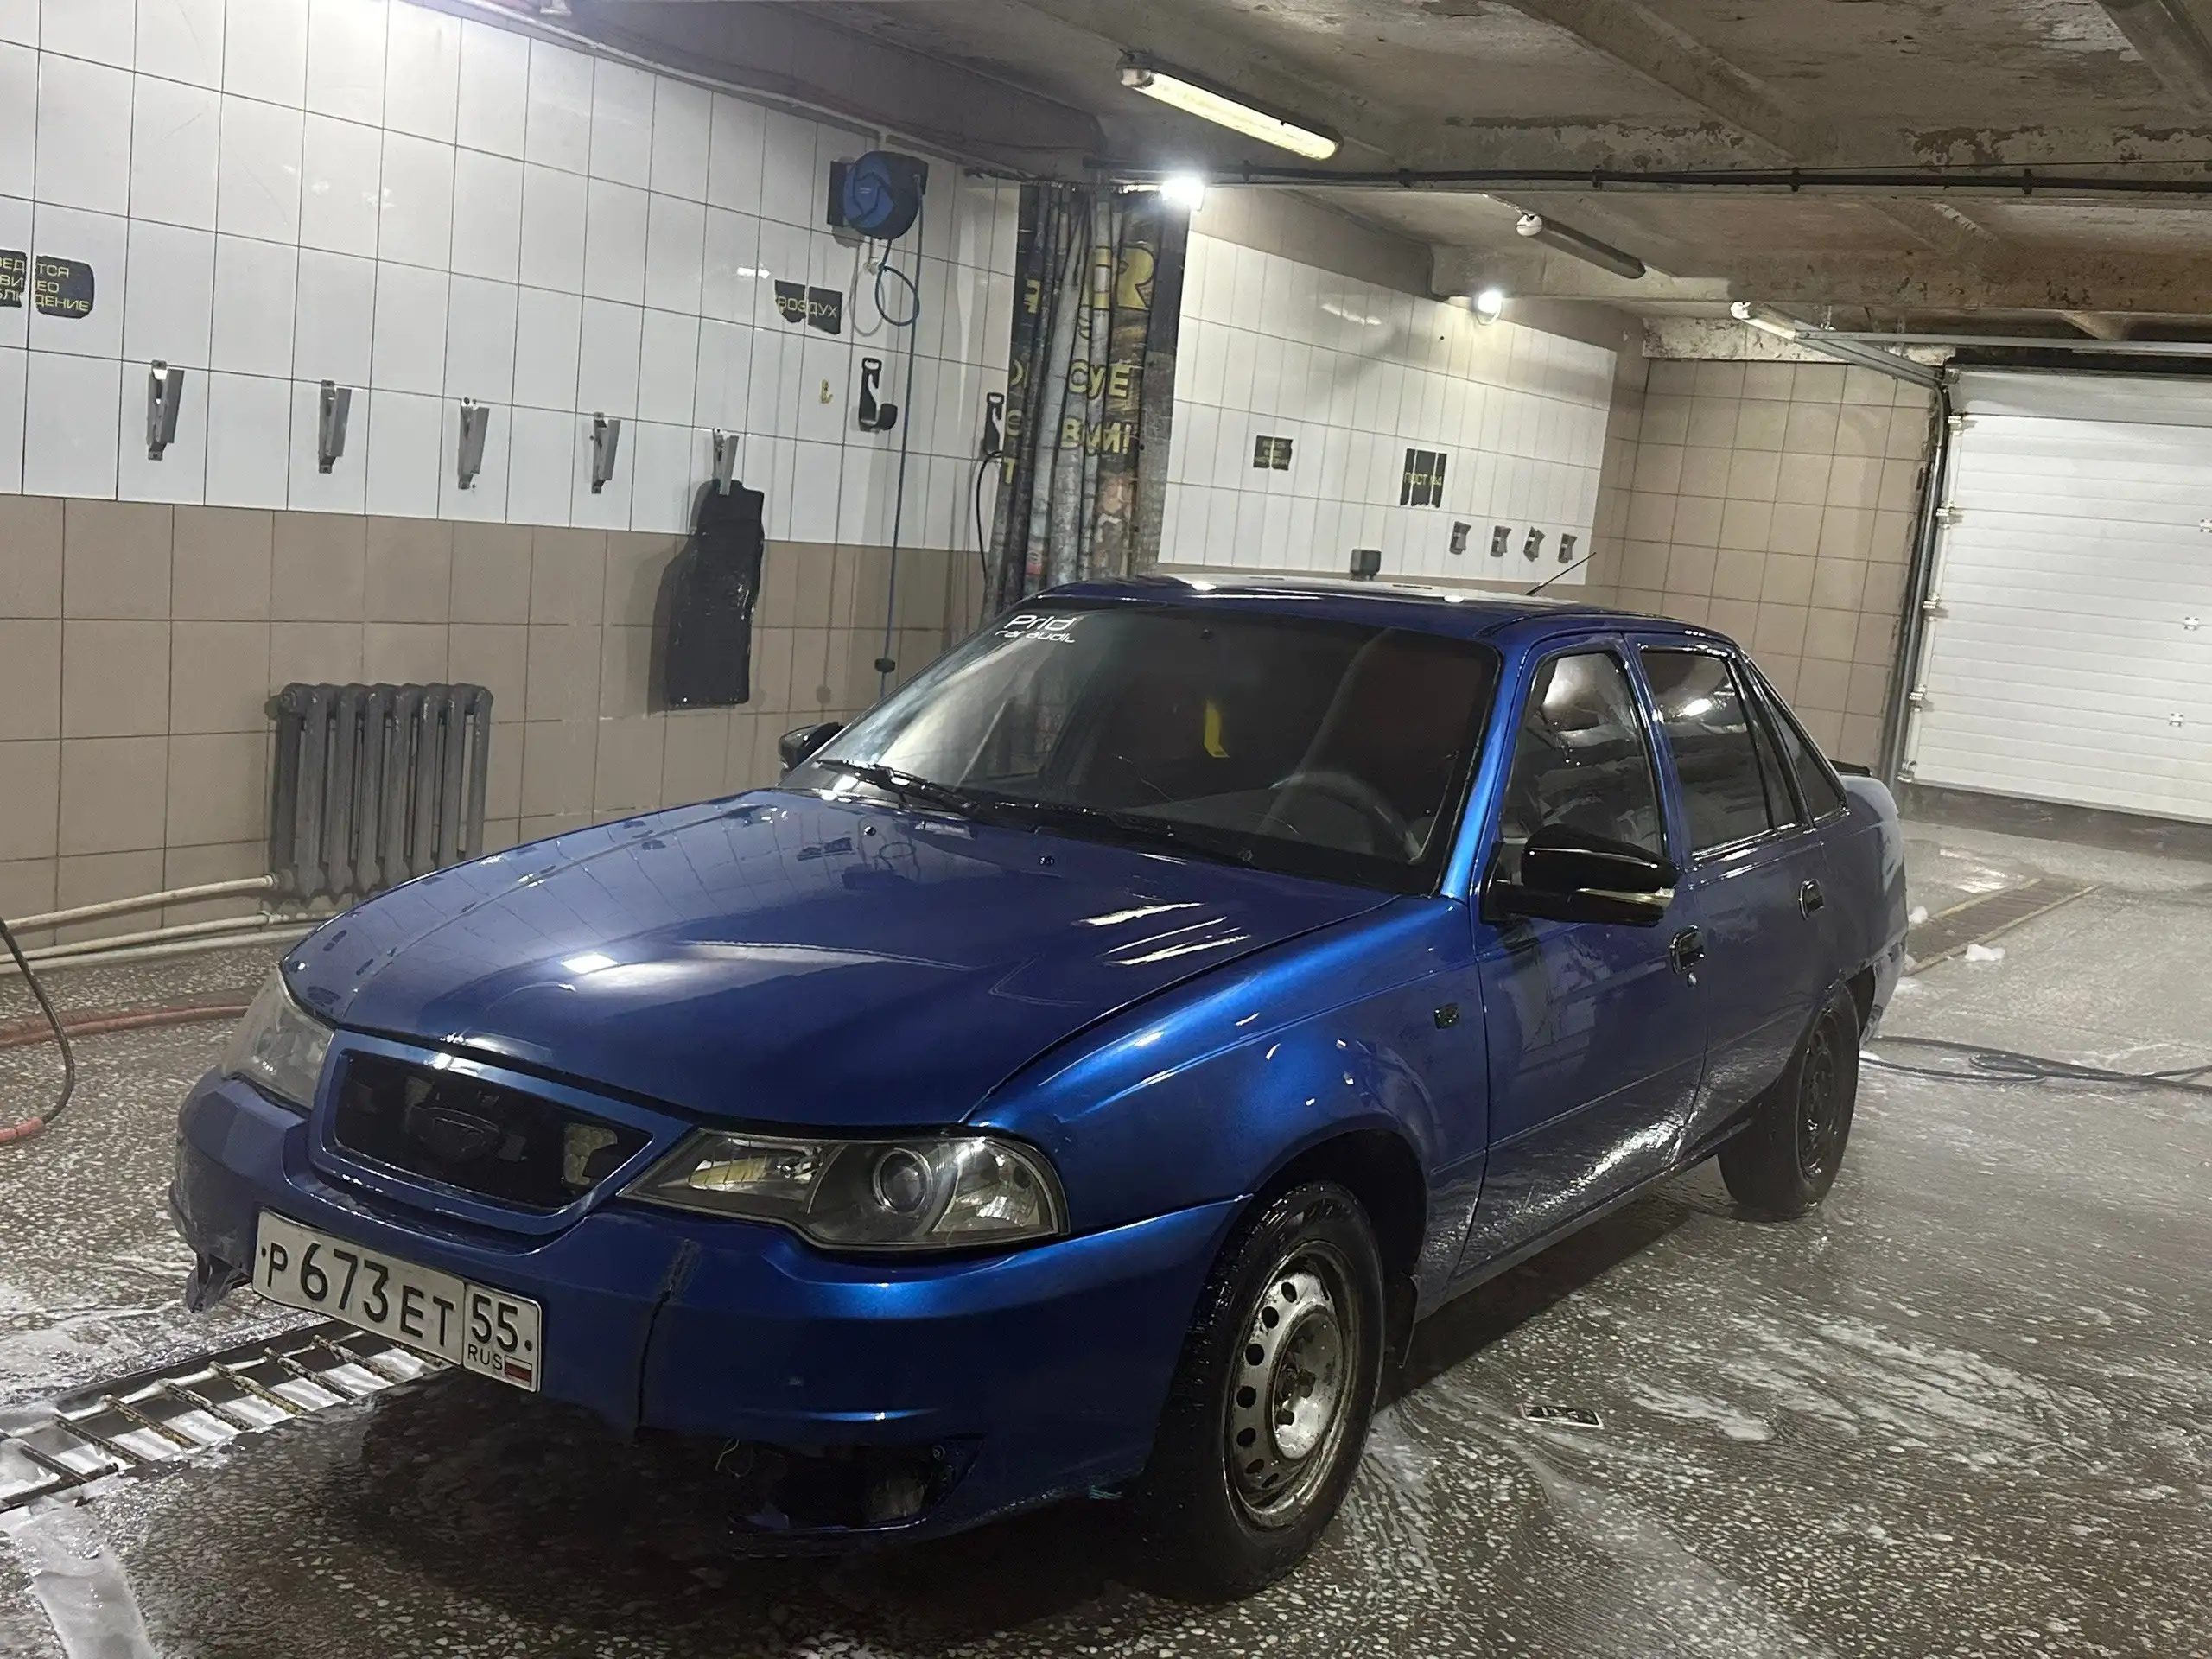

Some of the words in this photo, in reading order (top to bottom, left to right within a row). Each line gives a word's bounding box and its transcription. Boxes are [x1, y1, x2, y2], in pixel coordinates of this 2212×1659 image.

[778, 296, 838, 319] ВОЗДУХ
[472, 1293, 518, 1352] 55
[467, 1344, 504, 1370] RUS
